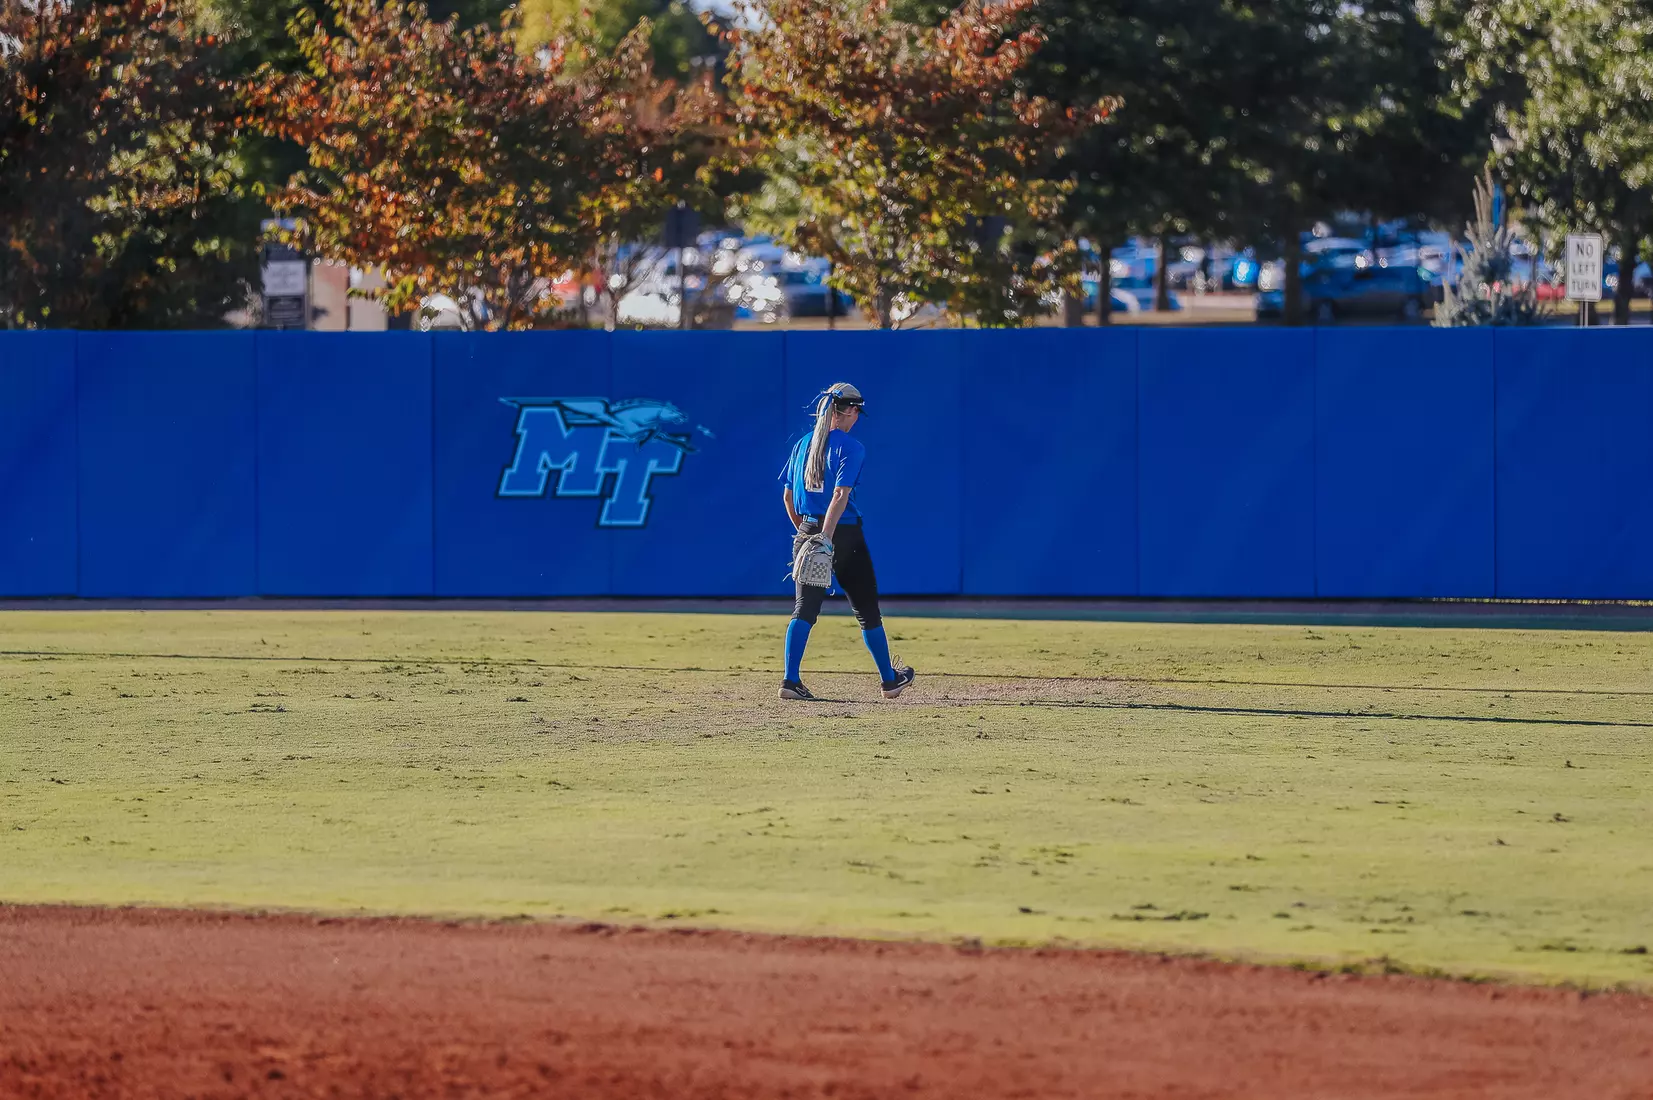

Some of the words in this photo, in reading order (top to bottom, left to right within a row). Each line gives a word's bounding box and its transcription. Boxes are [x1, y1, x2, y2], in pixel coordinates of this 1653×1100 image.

[1576, 242, 1594, 258] NO
[1572, 263, 1596, 275] LEFT
[1572, 280, 1597, 292] TURN
[496, 404, 686, 528] MT
